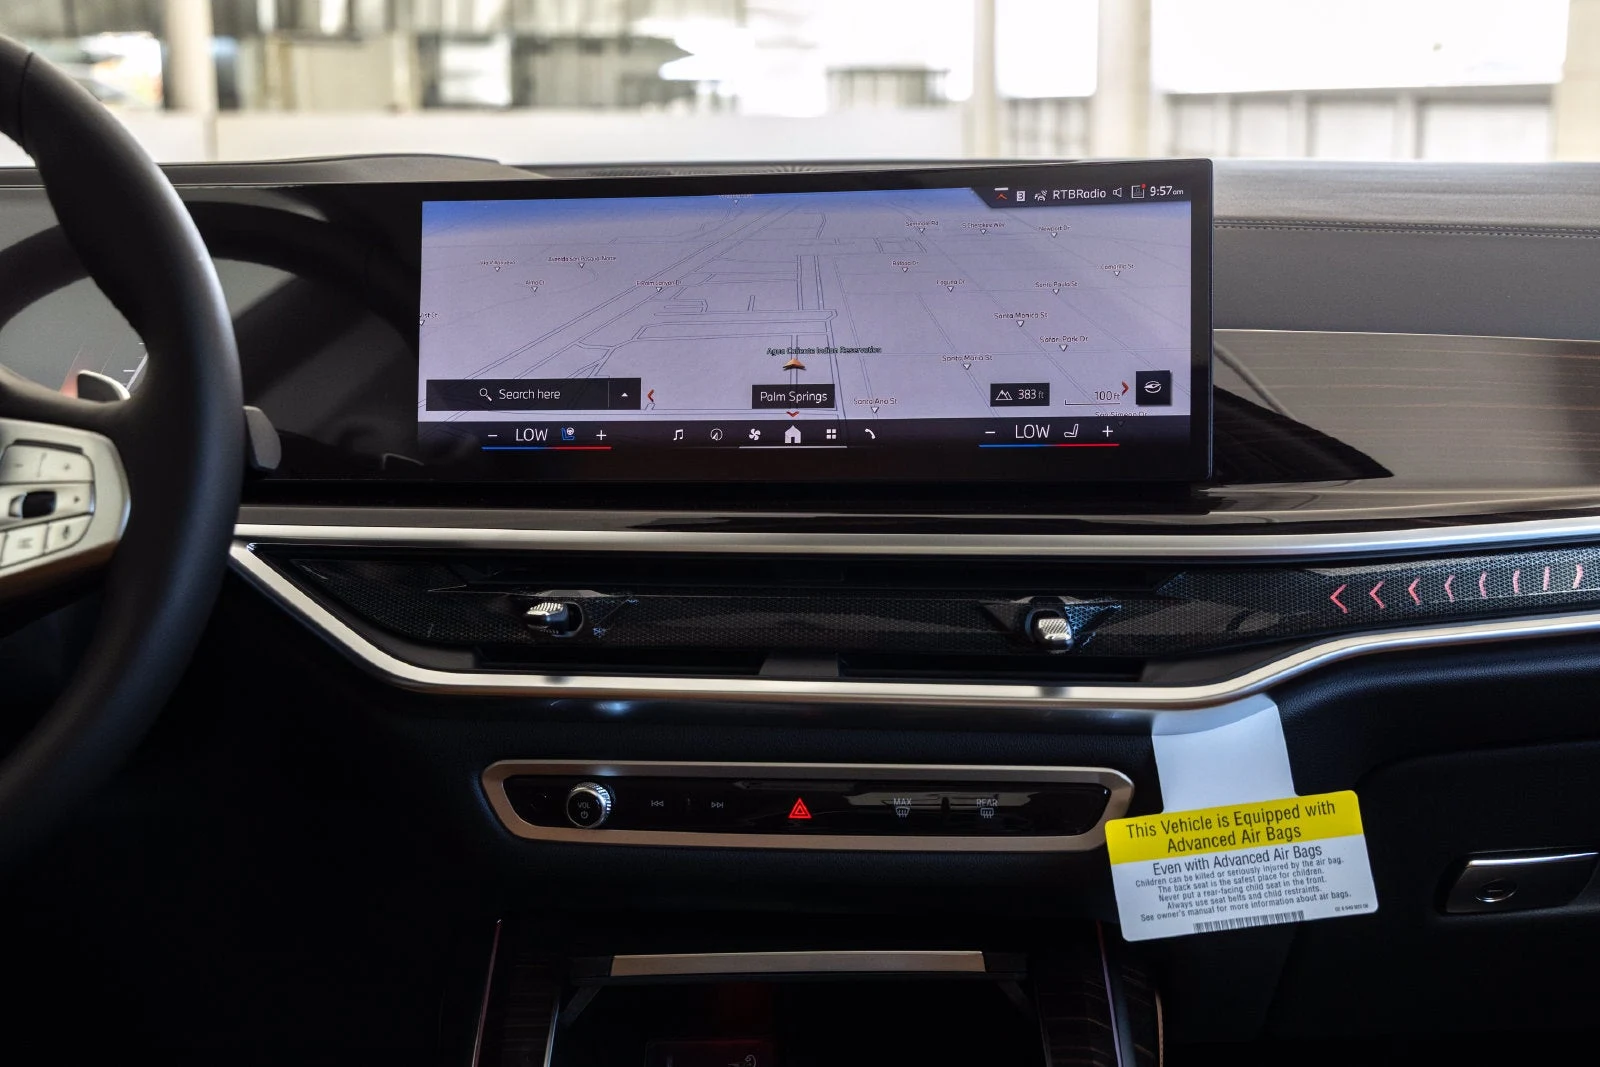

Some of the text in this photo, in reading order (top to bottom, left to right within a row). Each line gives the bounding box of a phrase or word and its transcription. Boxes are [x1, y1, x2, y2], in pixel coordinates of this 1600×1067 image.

[1052, 189, 1106, 200] RTBRadio
[498, 388, 561, 400] Search here
[760, 390, 828, 404] Palm Springs
[1018, 388, 1037, 400] 383
[516, 428, 548, 442] LOW
[1015, 424, 1050, 438] LOW
[893, 798, 912, 806] MAX
[976, 798, 998, 807] REAR
[1126, 800, 1336, 838] This Vehicle is Equipped with
[1168, 826, 1302, 853] Advanced Air Bags
[1152, 845, 1322, 876] Even with Advanced Air Bags
[1136, 878, 1166, 888] Children
[1195, 870, 1215, 880] killed
[1228, 864, 1260, 876] seriously
[1263, 863, 1288, 874] injured
[1291, 862, 1300, 870] by
[1302, 860, 1314, 868] the
[1328, 856, 1344, 866] bag.
[1158, 884, 1172, 894] The
[1174, 883, 1191, 892] back
[1194, 881, 1208, 890] seat
[1220, 878, 1232, 886] the
[1234, 874, 1256, 884] safest
[1258, 873, 1277, 884] place
[1292, 868, 1324, 877] children.
[1158, 894, 1180, 902] Never
[1182, 892, 1194, 900] put
[1204, 886, 1244, 896] rear-facing
[1246, 882, 1264, 892] child
[1266, 881, 1281, 890] seat
[1306, 876, 1327, 884] front.
[1168, 886, 1322, 910] Always use seat belts and child restraints.
[1140, 890, 1352, 922] See owner's manual for more information about air bags.
